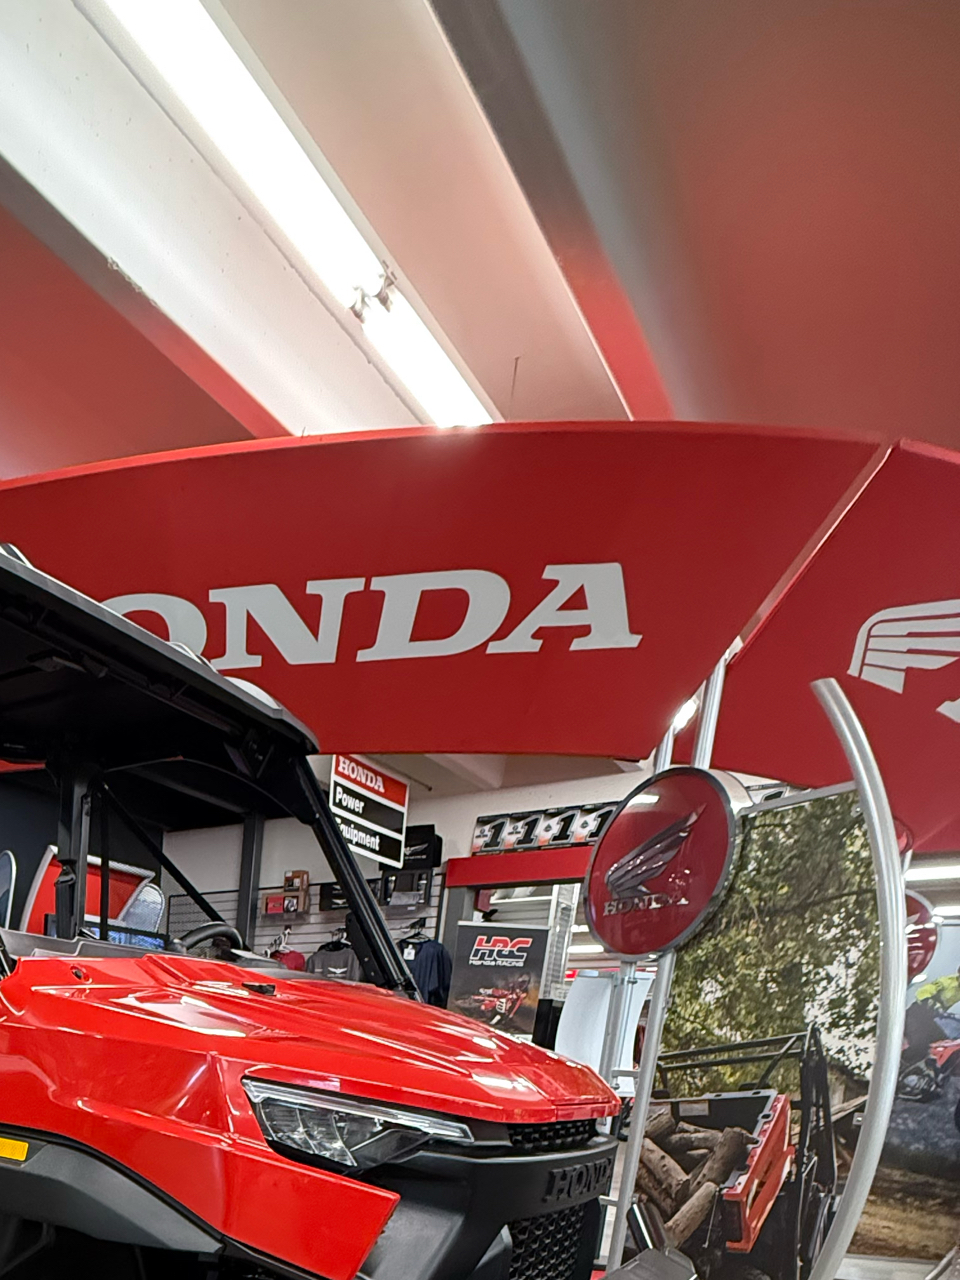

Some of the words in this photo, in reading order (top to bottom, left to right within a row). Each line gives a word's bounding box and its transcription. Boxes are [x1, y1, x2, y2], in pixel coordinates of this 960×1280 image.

[97, 562, 642, 671] ONDA
[338, 755, 385, 793] HONDA
[336, 786, 364, 813] Power
[469, 935, 533, 962] HRC
